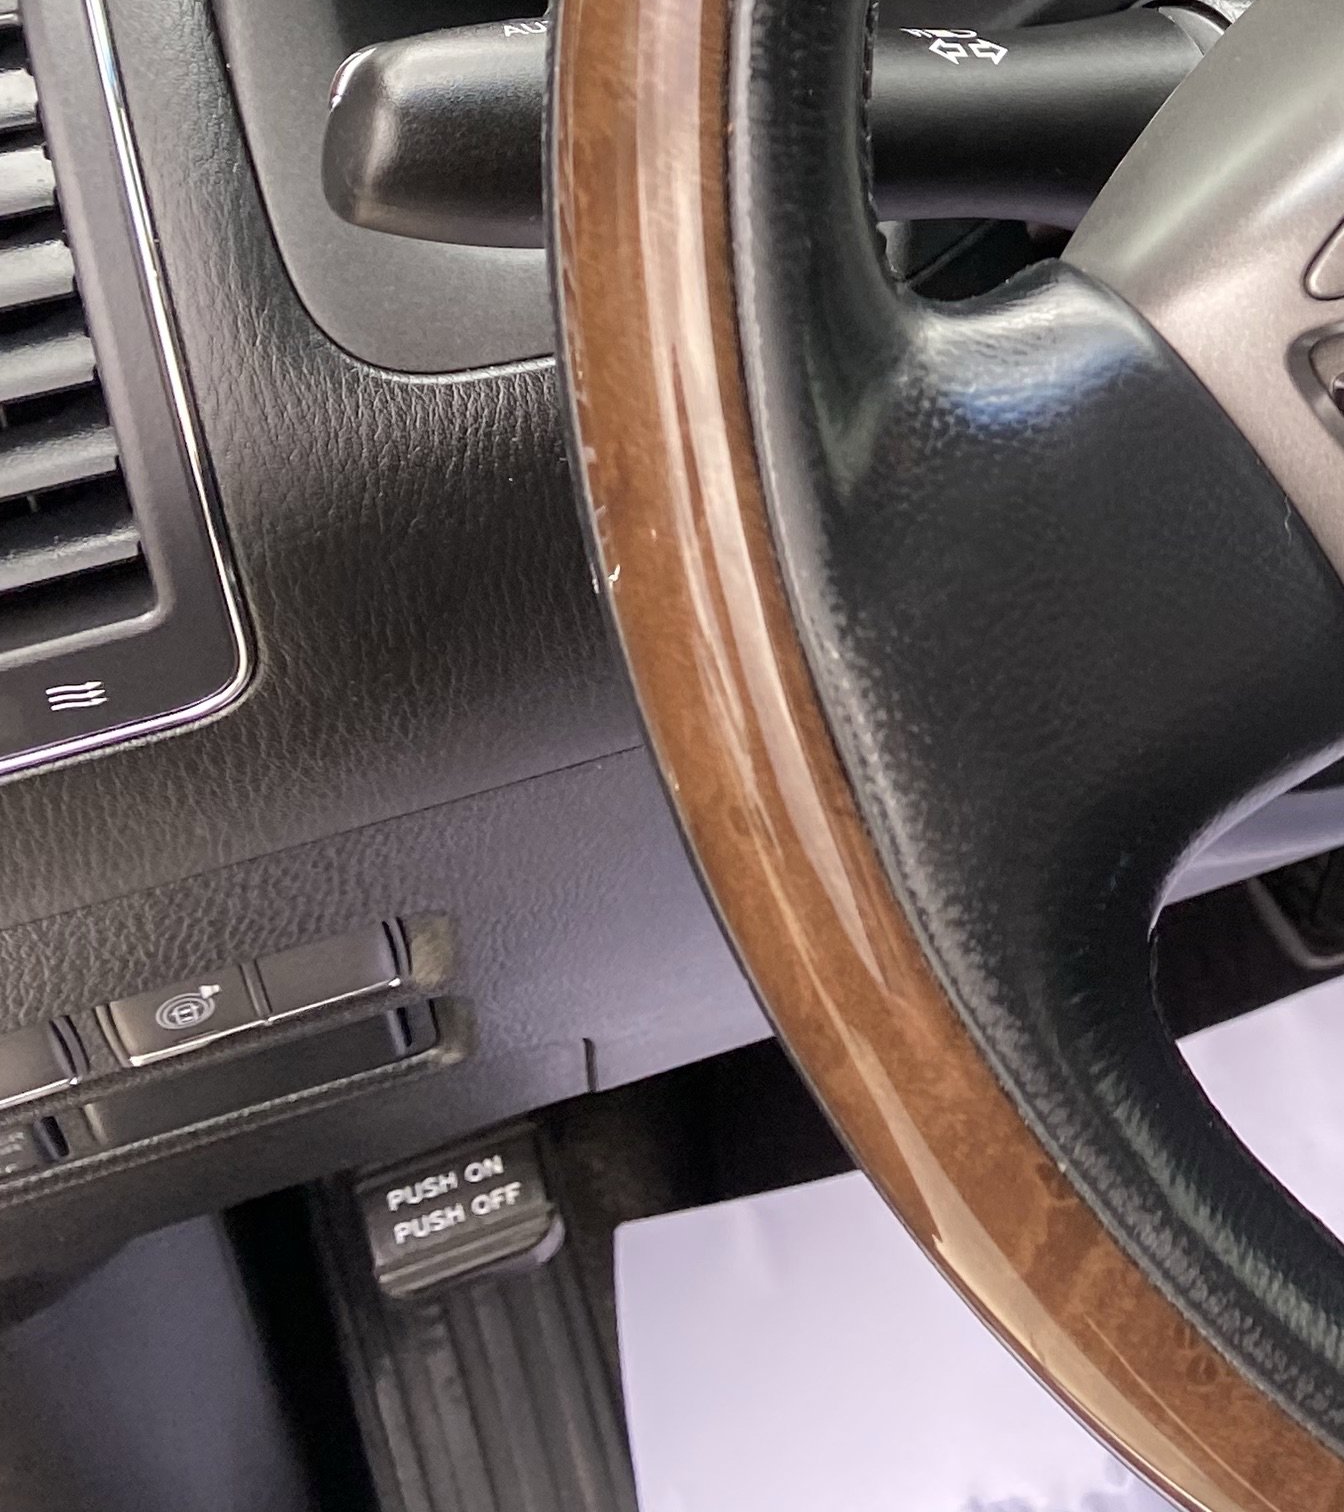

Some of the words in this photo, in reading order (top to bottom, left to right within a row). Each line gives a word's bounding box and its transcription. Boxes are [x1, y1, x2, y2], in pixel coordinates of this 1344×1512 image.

[386, 1171, 459, 1212] PUSH
[464, 1154, 504, 1183] ON
[393, 1202, 466, 1244] PUSH
[471, 1181, 522, 1216] OFF
